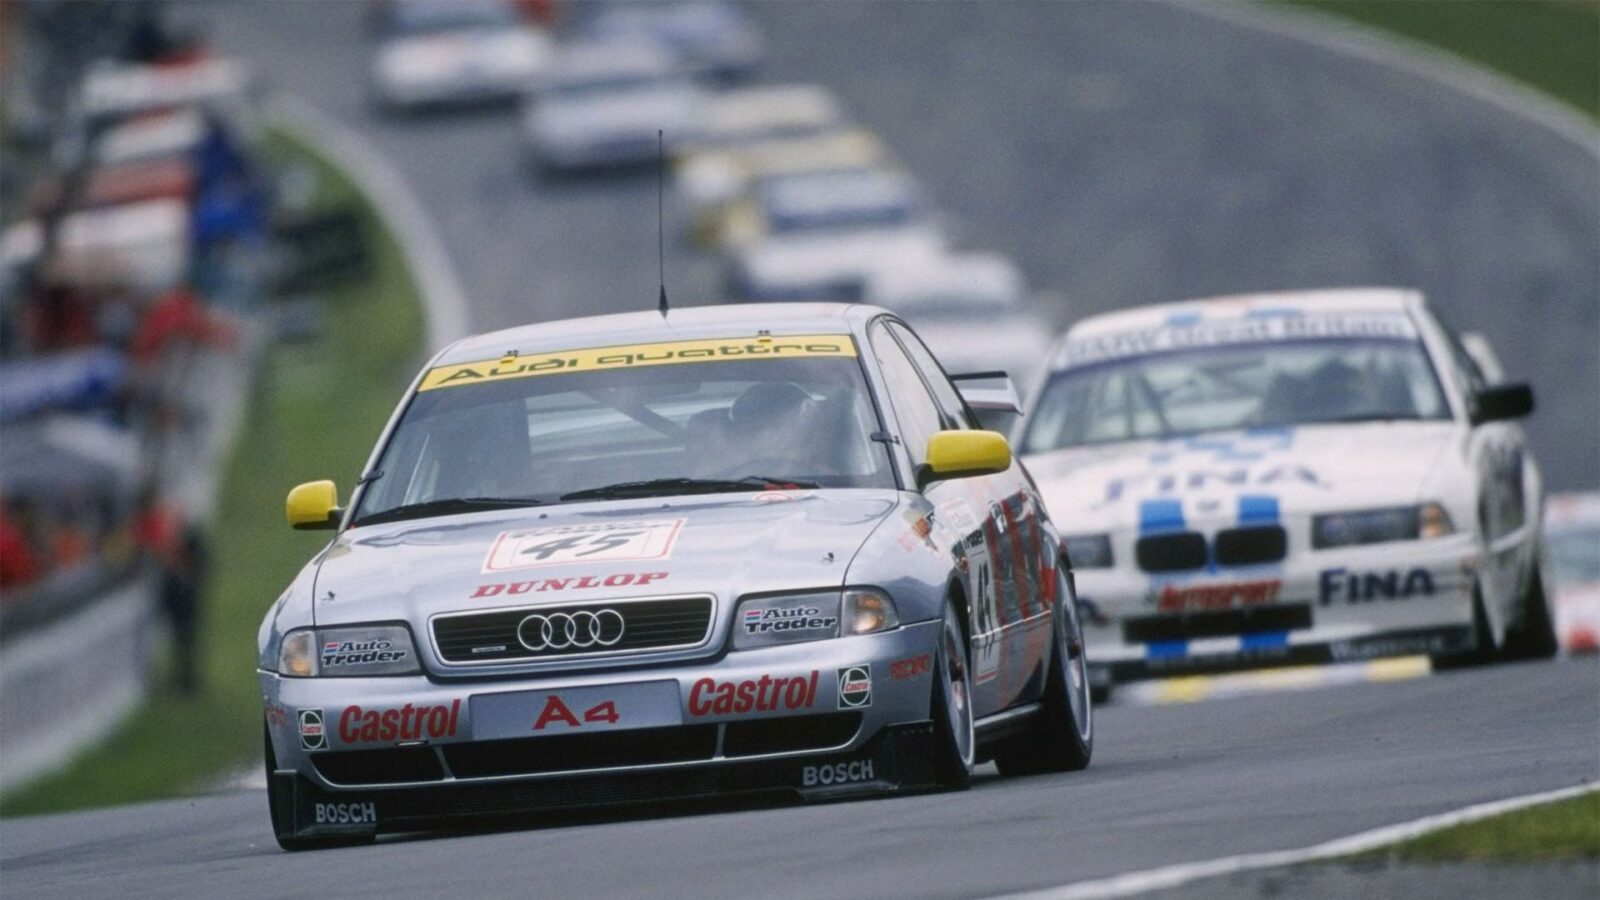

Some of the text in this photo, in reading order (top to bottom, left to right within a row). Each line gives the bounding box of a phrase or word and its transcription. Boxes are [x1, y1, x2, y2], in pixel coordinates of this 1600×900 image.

[436, 343, 841, 385] Audi quattro
[521, 530, 647, 560] 45
[469, 571, 670, 599] DUNLOP
[1319, 567, 1435, 607] FINA
[745, 616, 836, 634] Trader
[762, 606, 819, 618] Auto
[322, 650, 405, 667] Trader
[339, 640, 391, 651] Auto
[688, 670, 820, 717] Castrol
[338, 699, 462, 744] Castrol
[532, 695, 619, 730] A4
[802, 759, 874, 786] BOSCH
[315, 802, 376, 823] BOSCH
